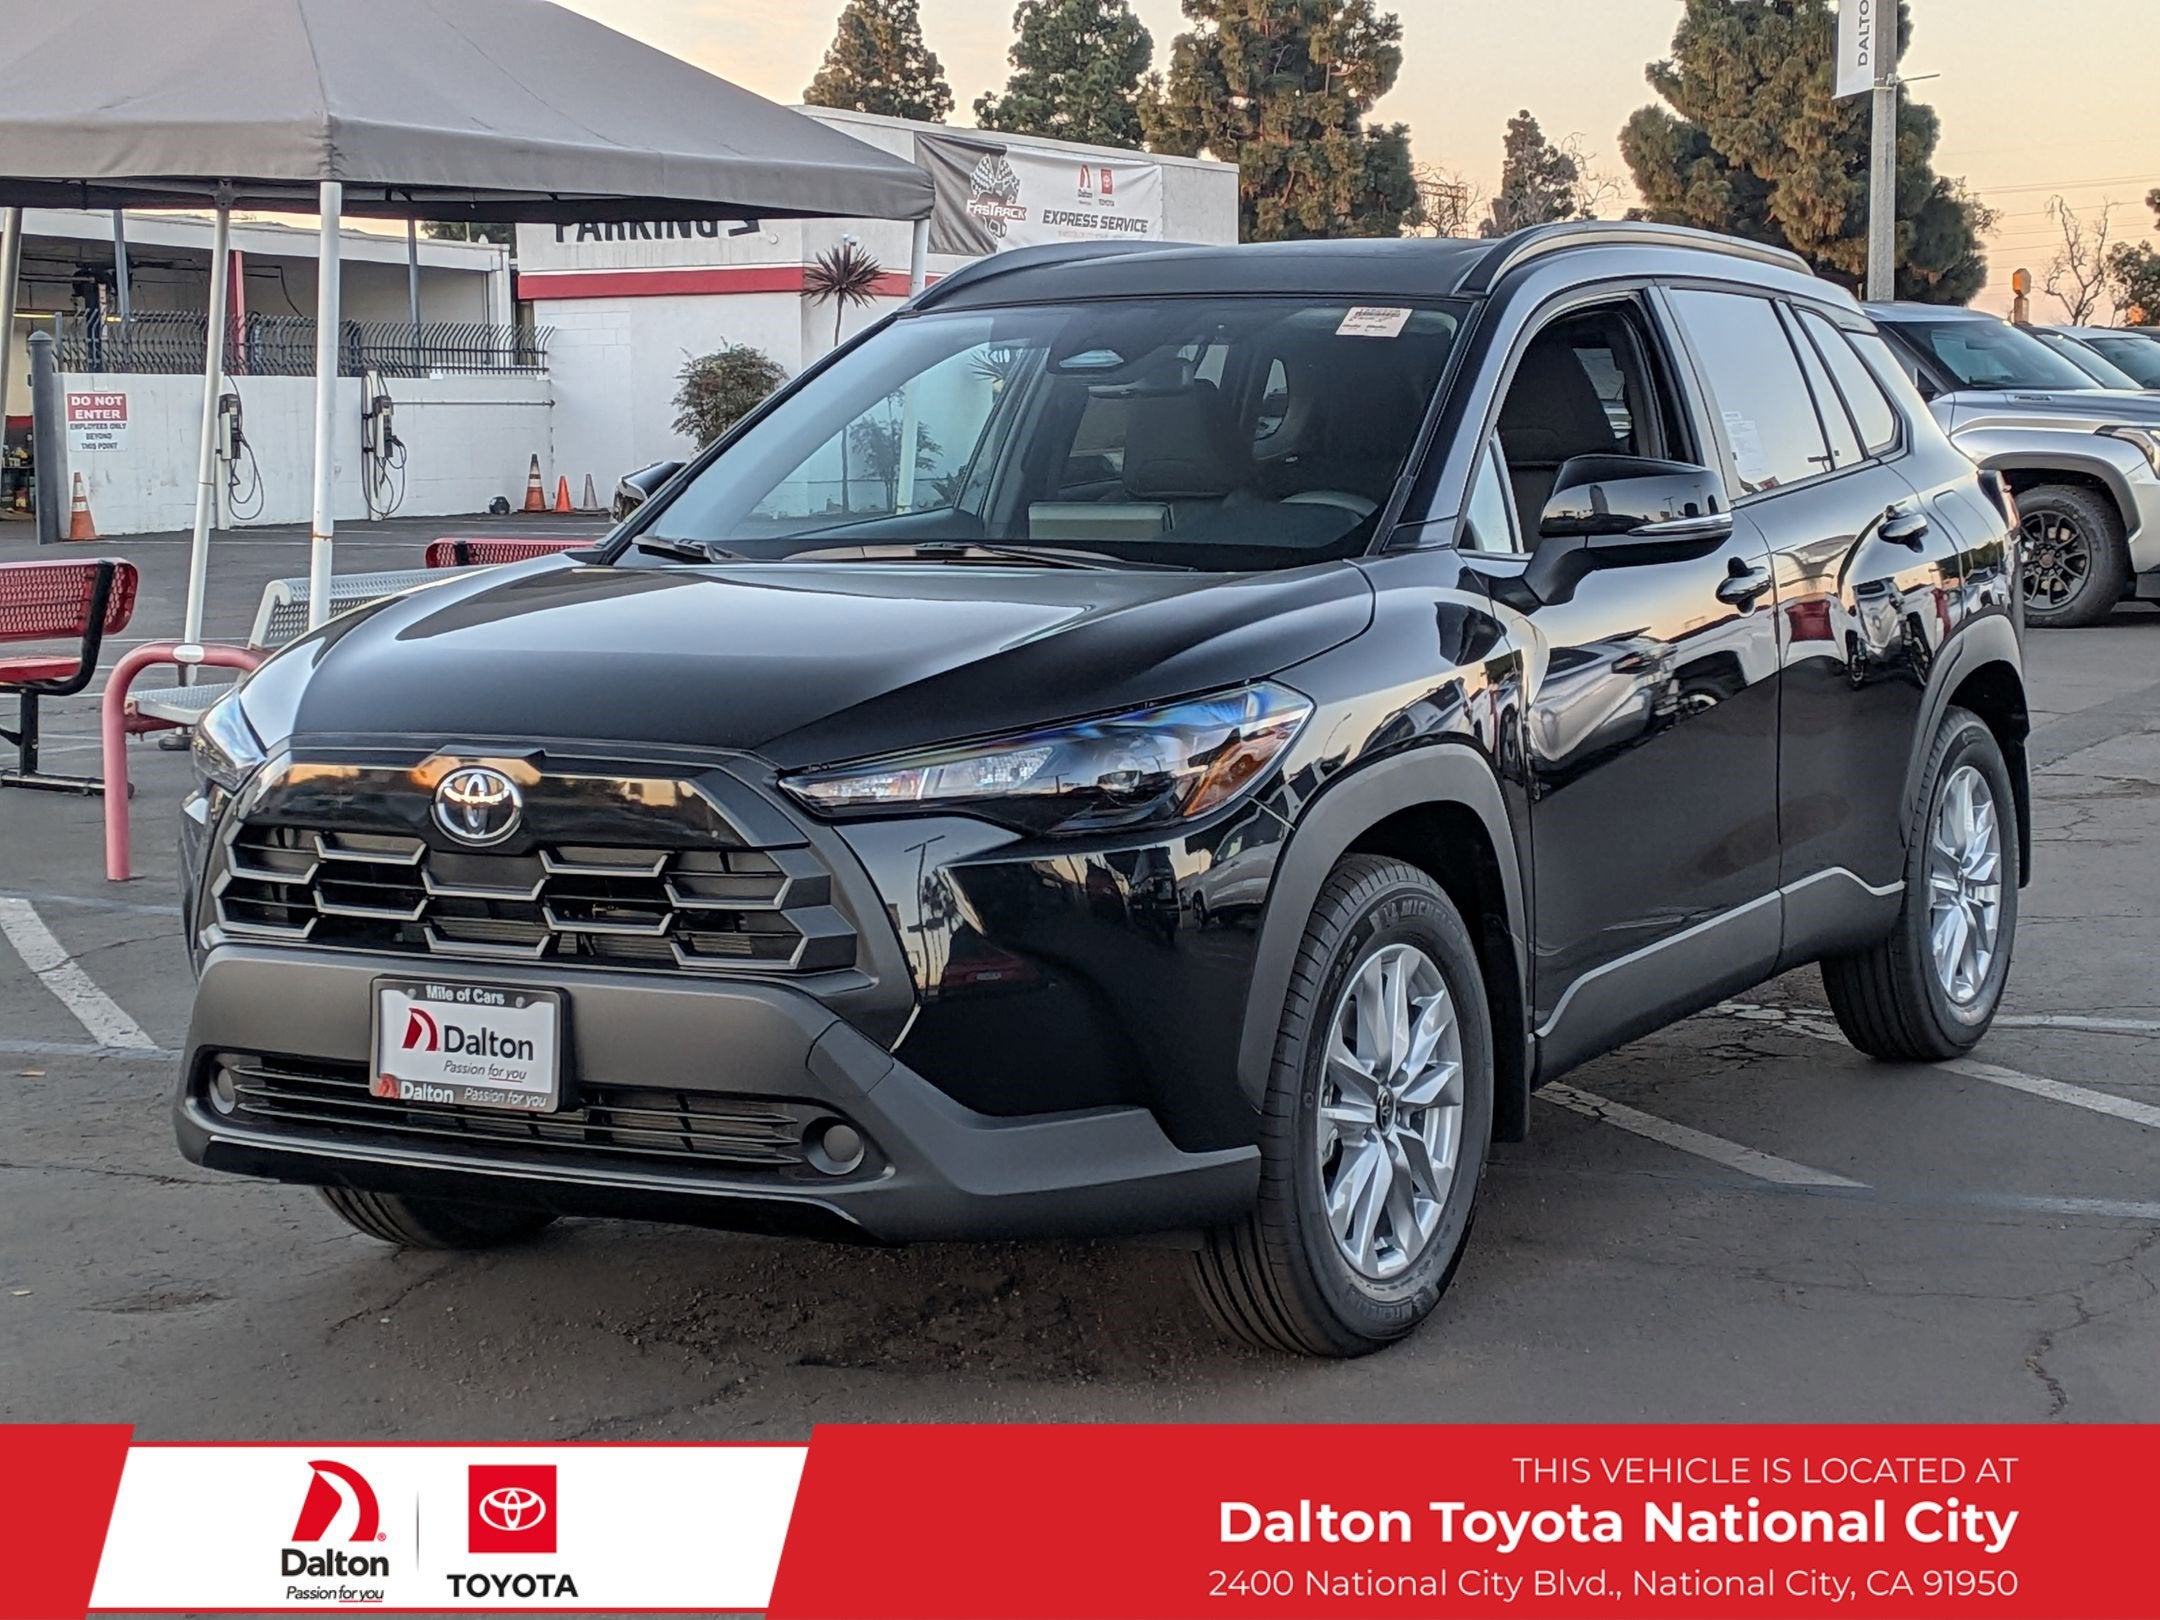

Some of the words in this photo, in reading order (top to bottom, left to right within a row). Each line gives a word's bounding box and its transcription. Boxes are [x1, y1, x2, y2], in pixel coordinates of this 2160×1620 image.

[1858, 0, 1870, 67] DALTO
[1042, 209, 1098, 228] EXPRESS
[1100, 215, 1149, 233] SERVICE
[71, 396, 91, 406] DO
[94, 396, 123, 406] NOT
[75, 409, 121, 419] ENTER
[425, 984, 453, 1001] Mile
[456, 987, 472, 1002] of
[472, 989, 505, 1005] Cars
[443, 1025, 534, 1061] Dalton
[443, 1059, 486, 1075] Passion
[488, 1063, 505, 1078] for
[505, 1067, 527, 1080] you
[400, 1081, 454, 1104] Dalton
[464, 1087, 505, 1103] Passion
[507, 1091, 524, 1105] for
[525, 1095, 547, 1108] you
